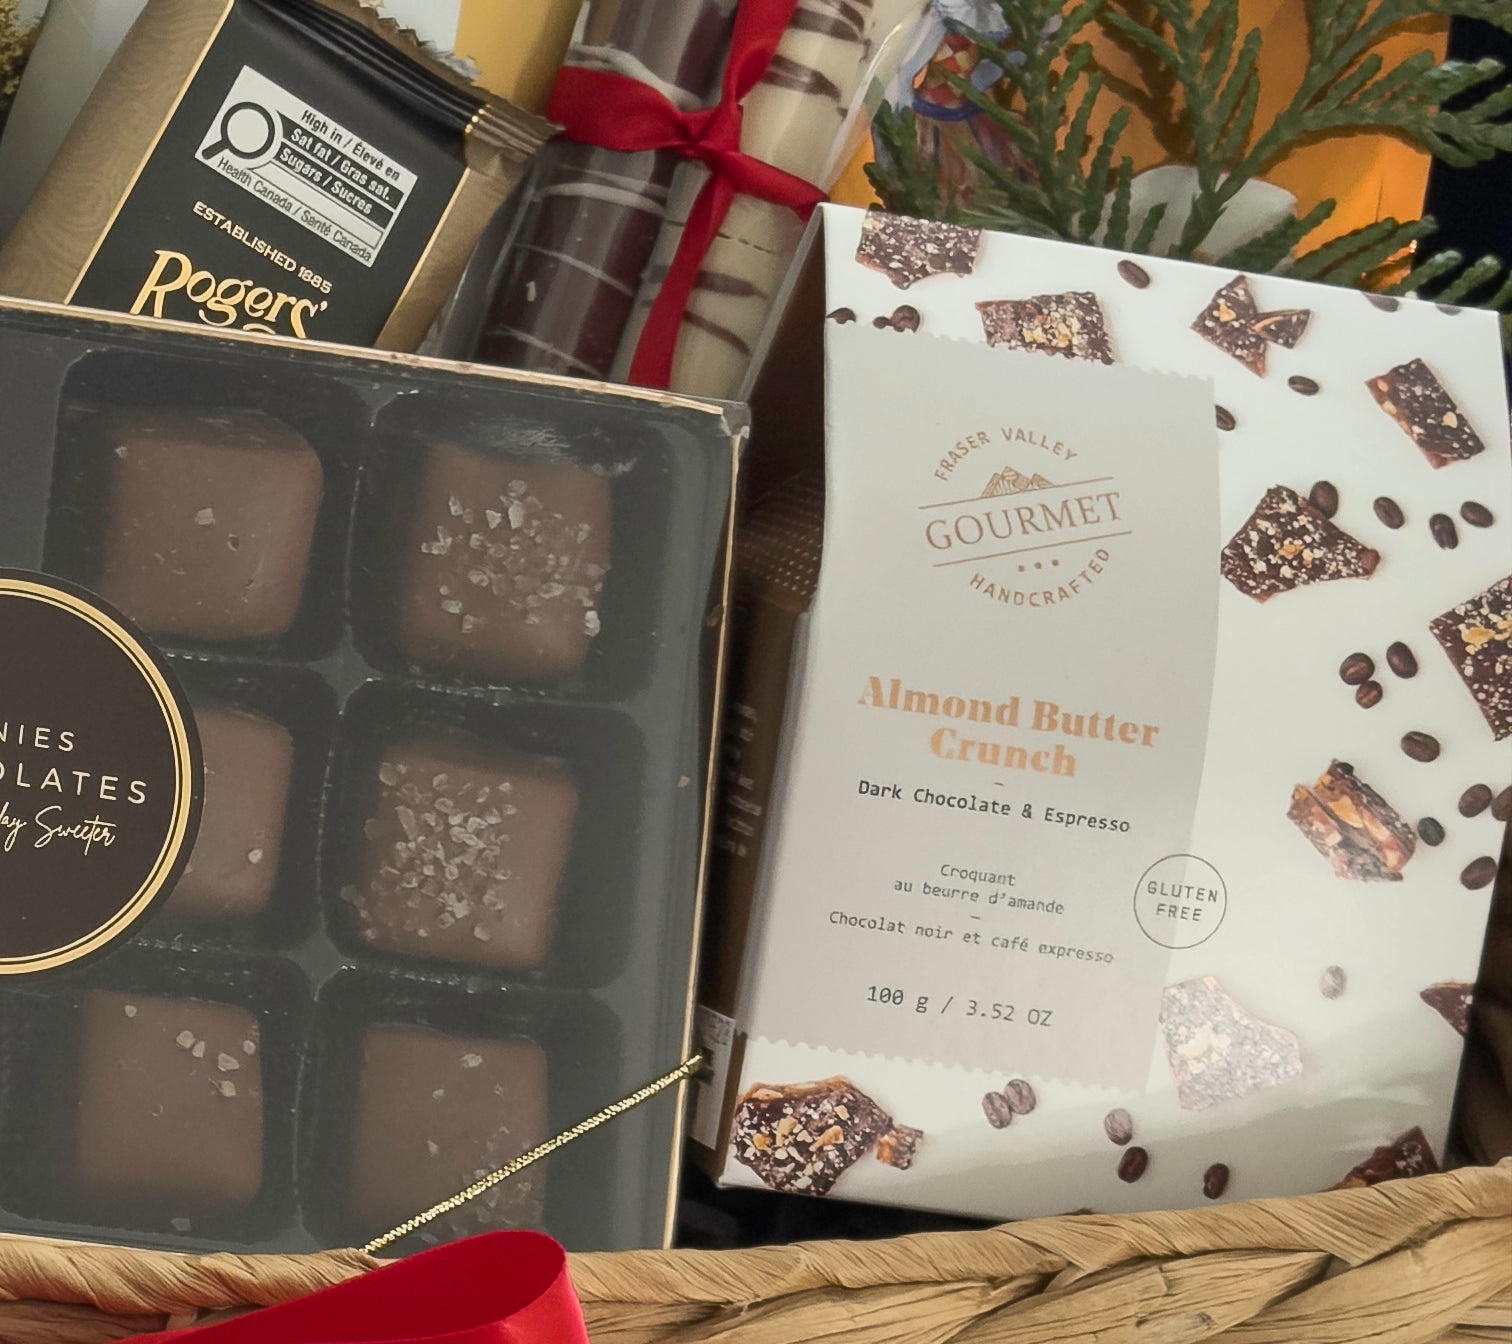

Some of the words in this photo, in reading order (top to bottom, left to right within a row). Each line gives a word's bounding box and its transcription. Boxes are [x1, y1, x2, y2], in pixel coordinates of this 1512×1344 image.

[290, 128, 313, 150] Sat
[339, 161, 367, 186] Gras
[368, 177, 390, 201] sat.
[301, 109, 330, 136] High
[330, 127, 343, 144] in
[351, 141, 385, 170] Élevé
[384, 166, 401, 181] en
[279, 148, 323, 185] Sugars
[330, 182, 373, 215] Sucres
[217, 156, 252, 186] Health
[252, 180, 294, 213] Canada
[301, 210, 332, 237] Santé
[332, 229, 372, 262] Canada
[193, 201, 297, 273] ESTABLISHED
[298, 266, 333, 295] 1885
[934, 430, 991, 481] FRASER
[1001, 427, 1078, 461] VALLEY
[925, 491, 1121, 550] GOURMET
[969, 548, 1110, 607] HANDCRAFTED
[857, 675, 1021, 728] Almond
[1031, 699, 1161, 748] Butter
[929, 727, 1078, 778] Crunch
[34, 805, 118, 856] Sweeter
[858, 779, 903, 801] Dark
[913, 788, 1012, 816] Chocolate
[1021, 803, 1033, 820] &
[1044, 807, 1130, 834] Espresso
[893, 880, 913, 893] au
[922, 881, 980, 902] beurre
[988, 892, 1065, 915] d'amande
[940, 864, 1016, 887] Croquant
[1147, 880, 1218, 903] GLUTEN
[829, 910, 906, 934] Chocolat
[914, 924, 954, 940] noir
[963, 931, 981, 944] et
[991, 934, 1029, 952] café
[1038, 941, 1115, 964] expresso
[1155, 903, 1203, 922] FREE
[866, 985, 904, 1006] 100
[915, 995, 929, 1014] g
[940, 995, 954, 1014] /
[966, 999, 1015, 1022] 3.52
[1027, 1008, 1054, 1027] OZ
